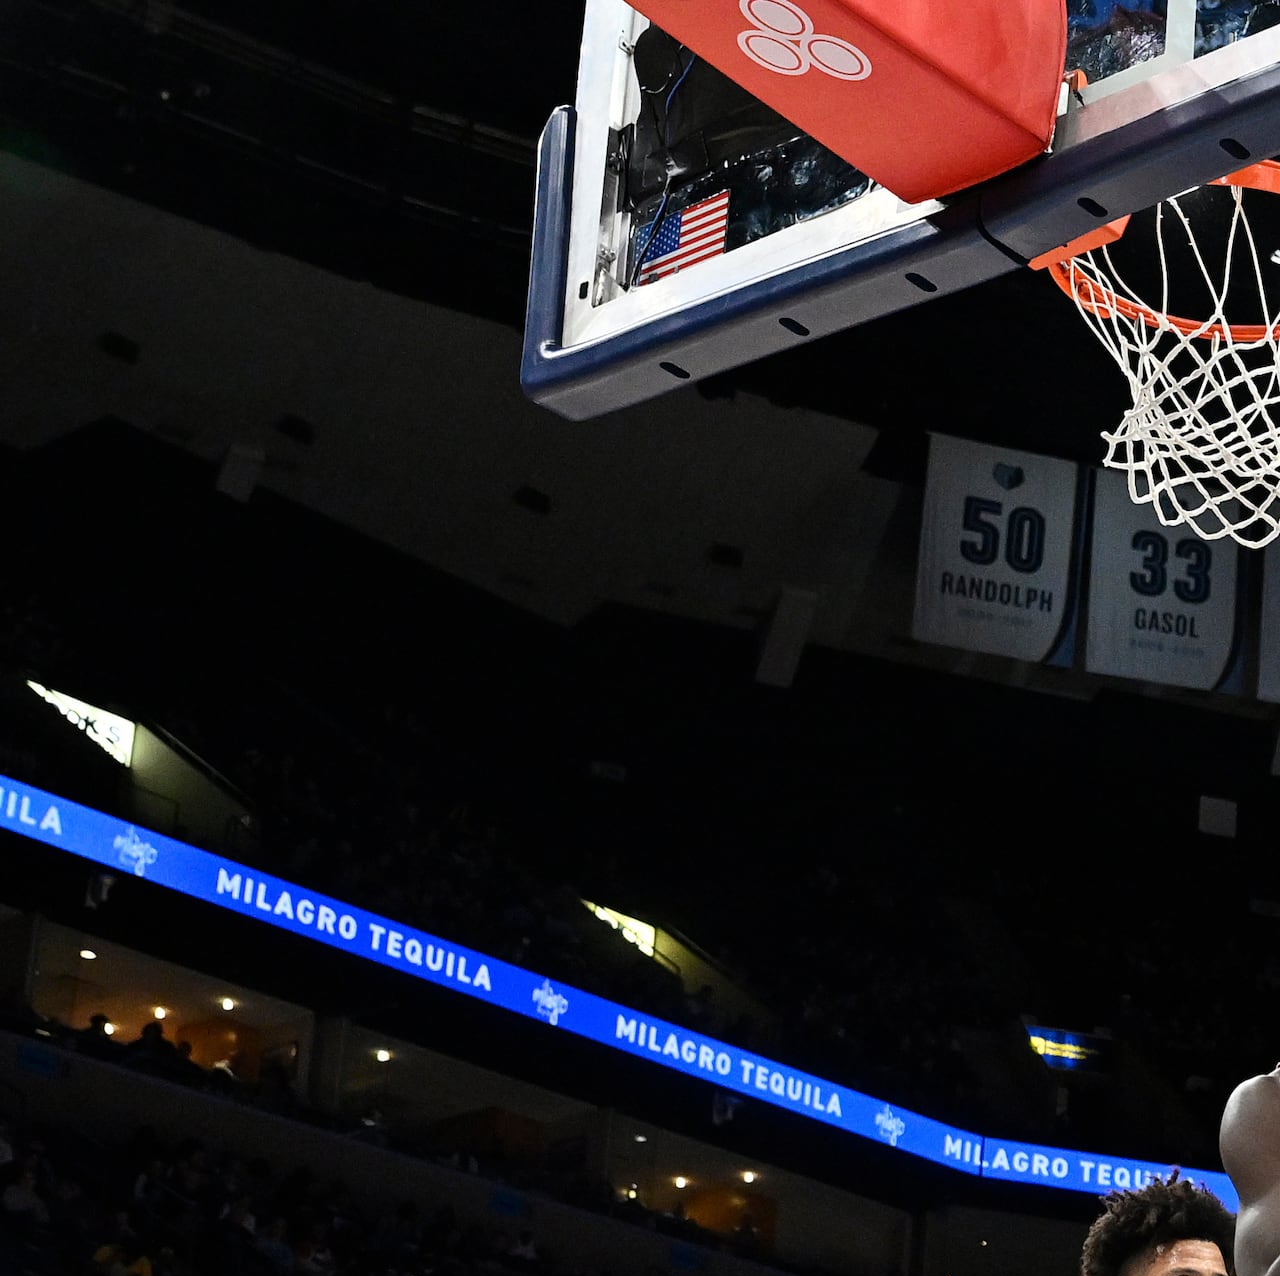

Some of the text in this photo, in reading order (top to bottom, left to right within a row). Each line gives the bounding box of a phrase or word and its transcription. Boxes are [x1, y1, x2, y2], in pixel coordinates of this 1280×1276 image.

[960, 495, 1046, 574] 50
[1130, 529, 1212, 605] 33
[941, 572, 1053, 613] RANDOLPH
[1135, 608, 1199, 639] GASOL
[216, 866, 492, 992] MILAGRO TEQUILA
[615, 1013, 842, 1118] MILAGRO TEQUILA
[944, 1133, 1069, 1179] MILAGRO
